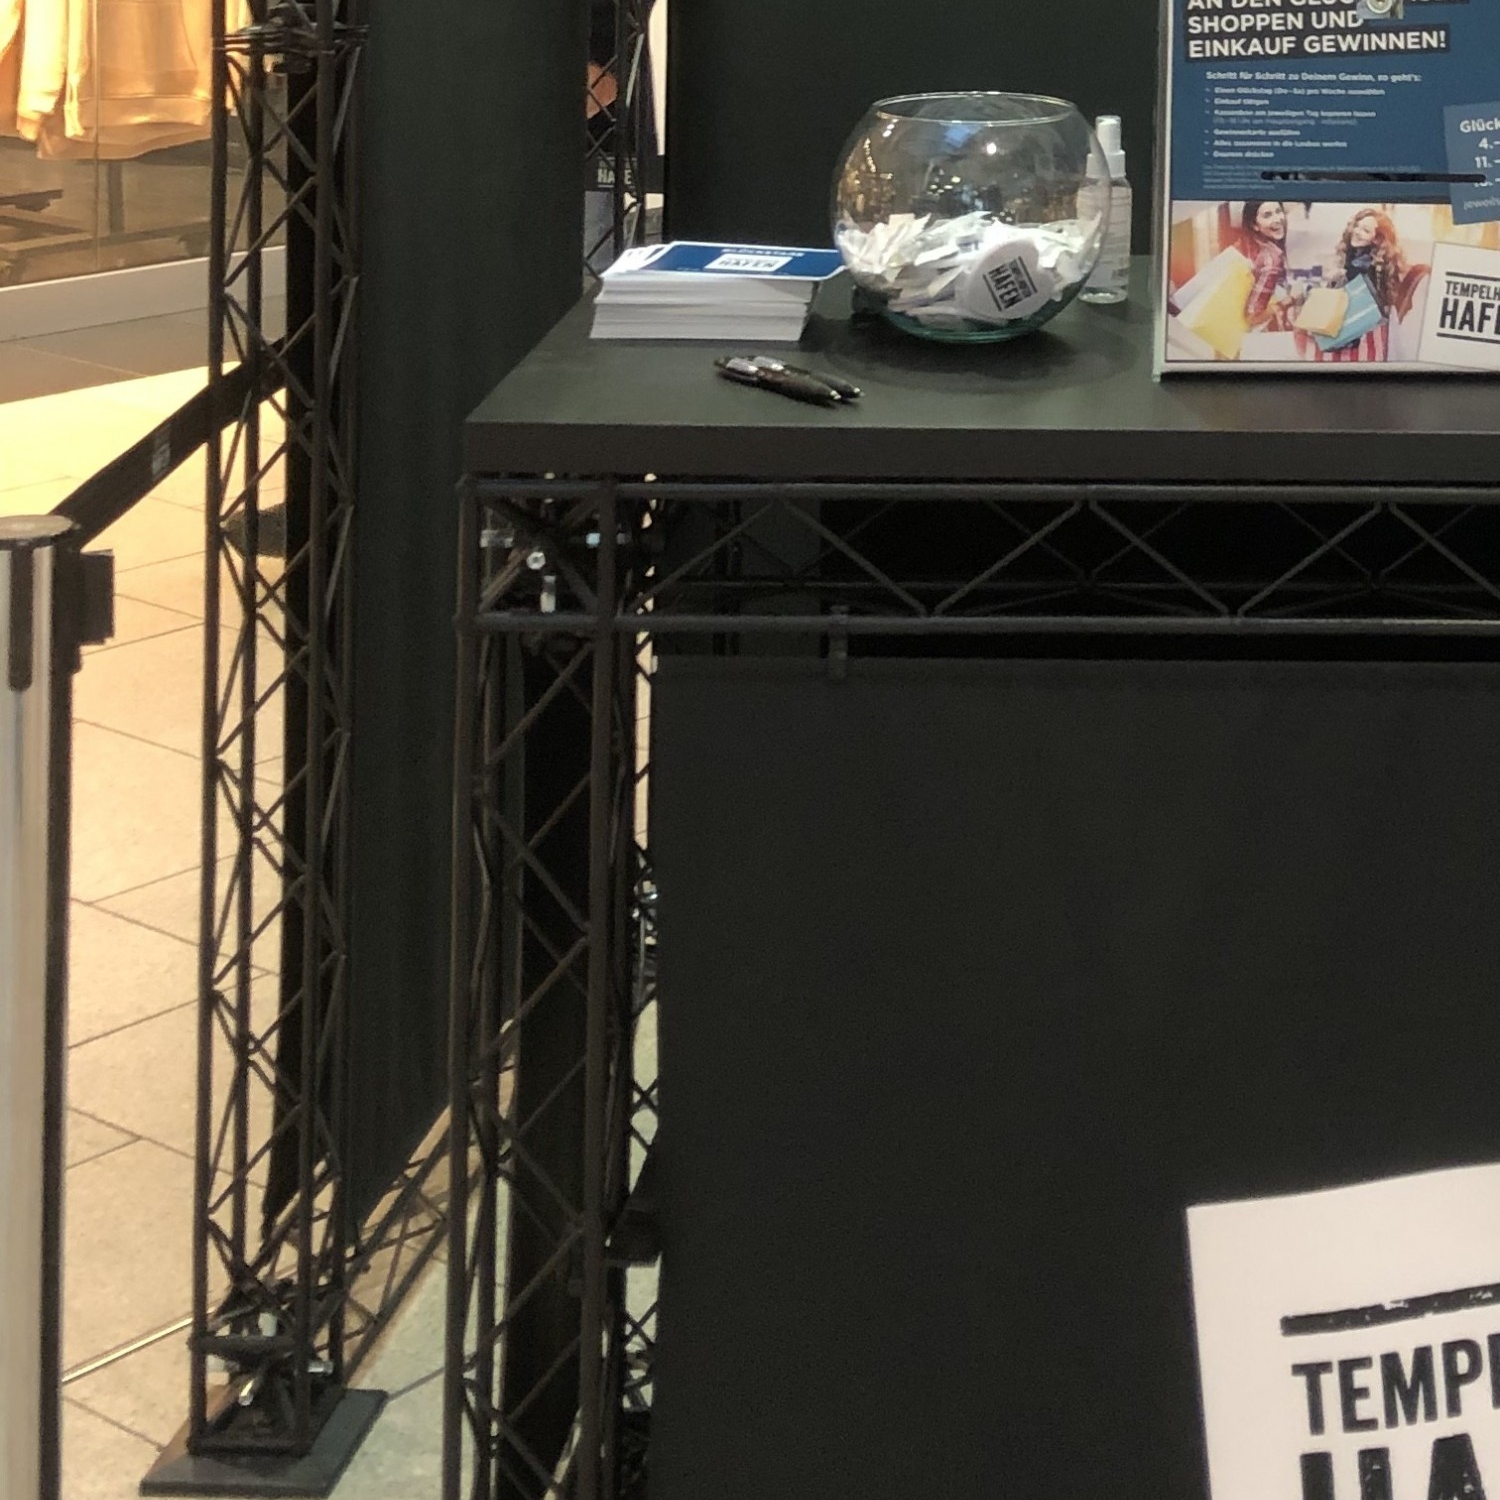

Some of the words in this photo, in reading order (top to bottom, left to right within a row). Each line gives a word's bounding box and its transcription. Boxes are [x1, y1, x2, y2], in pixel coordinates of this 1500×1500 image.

[1188, 12, 1304, 35] SHOPPEN
[1311, 10, 1364, 29] UND
[1189, 35, 1297, 58] EINKAUF
[1303, 30, 1447, 53] GEWINNEN!
